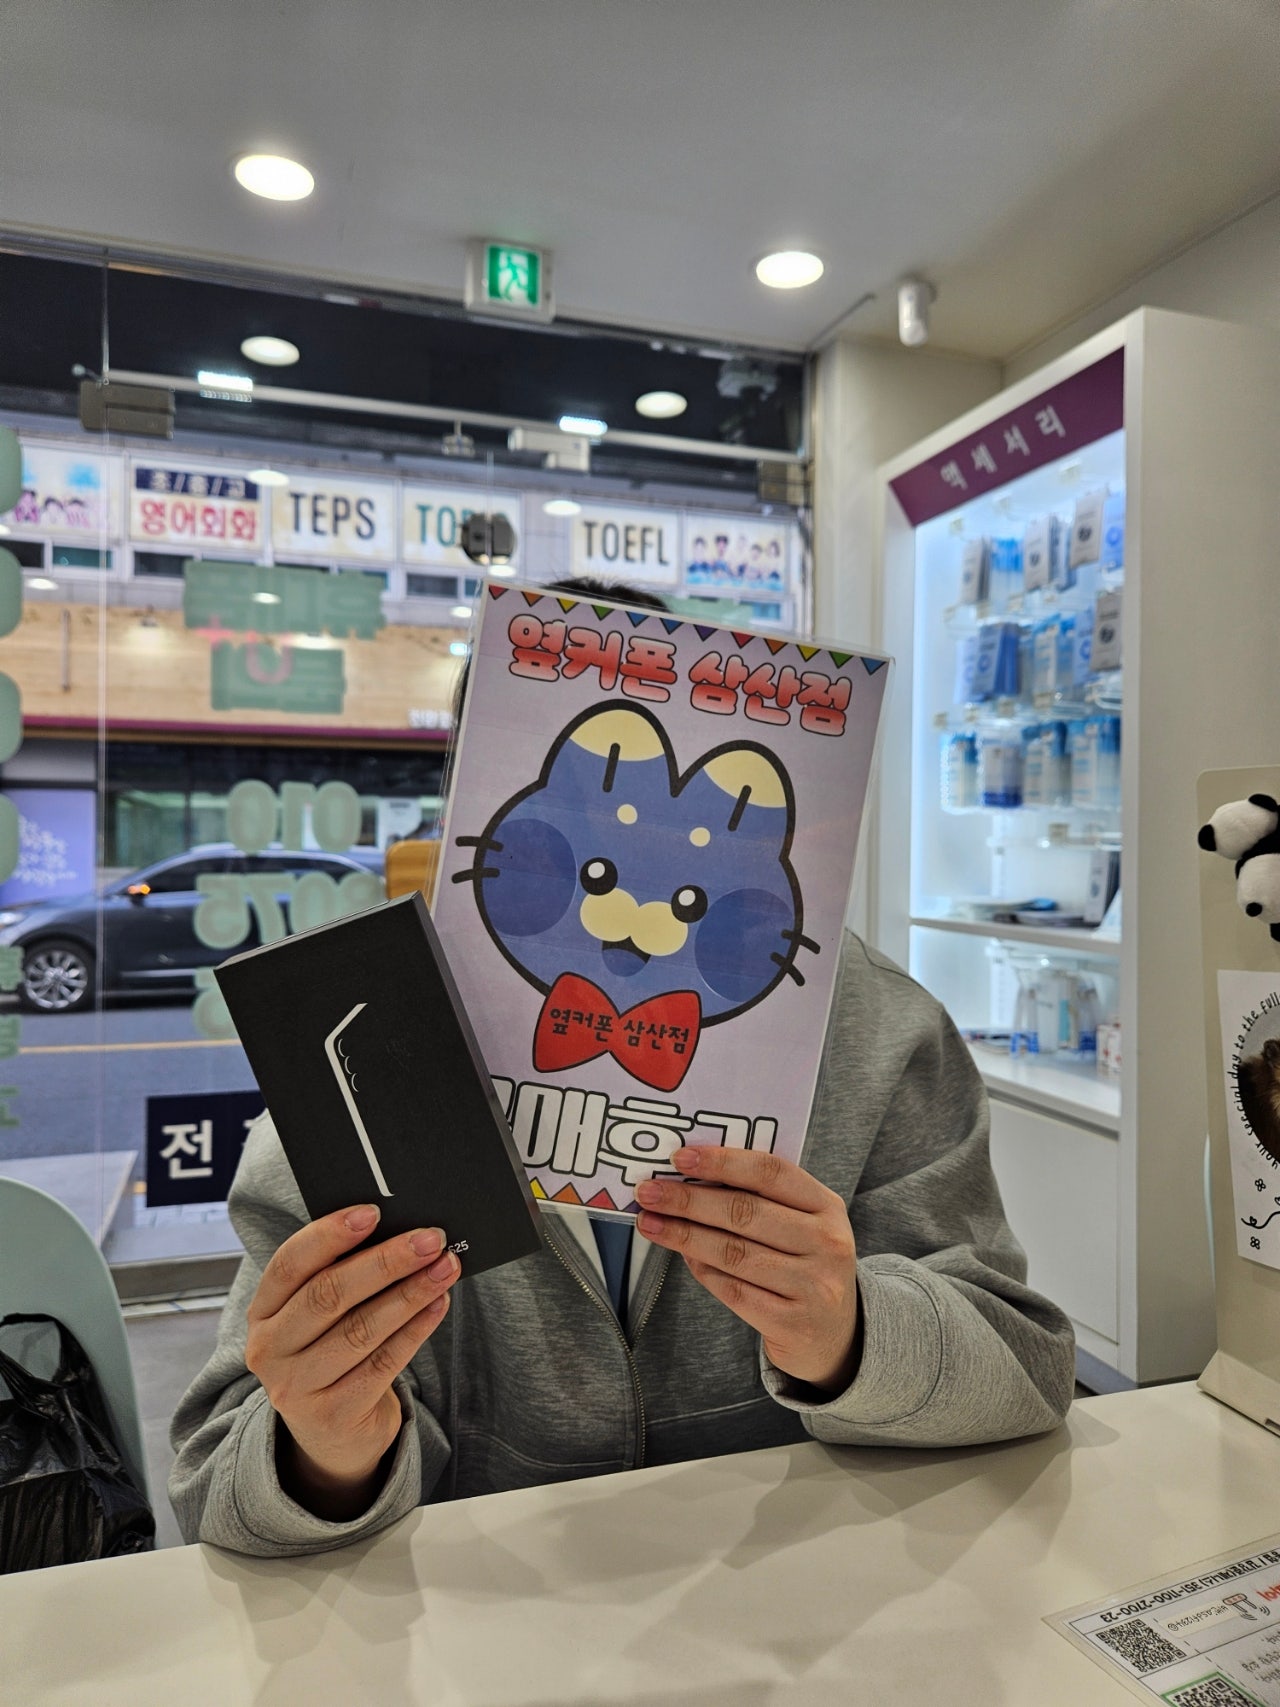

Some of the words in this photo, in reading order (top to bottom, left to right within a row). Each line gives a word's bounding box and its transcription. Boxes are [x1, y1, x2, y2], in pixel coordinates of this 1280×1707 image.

[140, 498, 257, 542] 영어회화
[289, 491, 377, 541] TEPS
[583, 520, 670, 566] TOEFL
[508, 613, 678, 703] 옆커폰
[687, 651, 853, 737] 삼산점
[550, 1008, 614, 1042] 옆커폰
[623, 1021, 690, 1055] 삼산점
[1227, 1053, 1242, 1080] day
[1235, 1034, 1246, 1050] to
[1242, 1010, 1260, 1033] the
